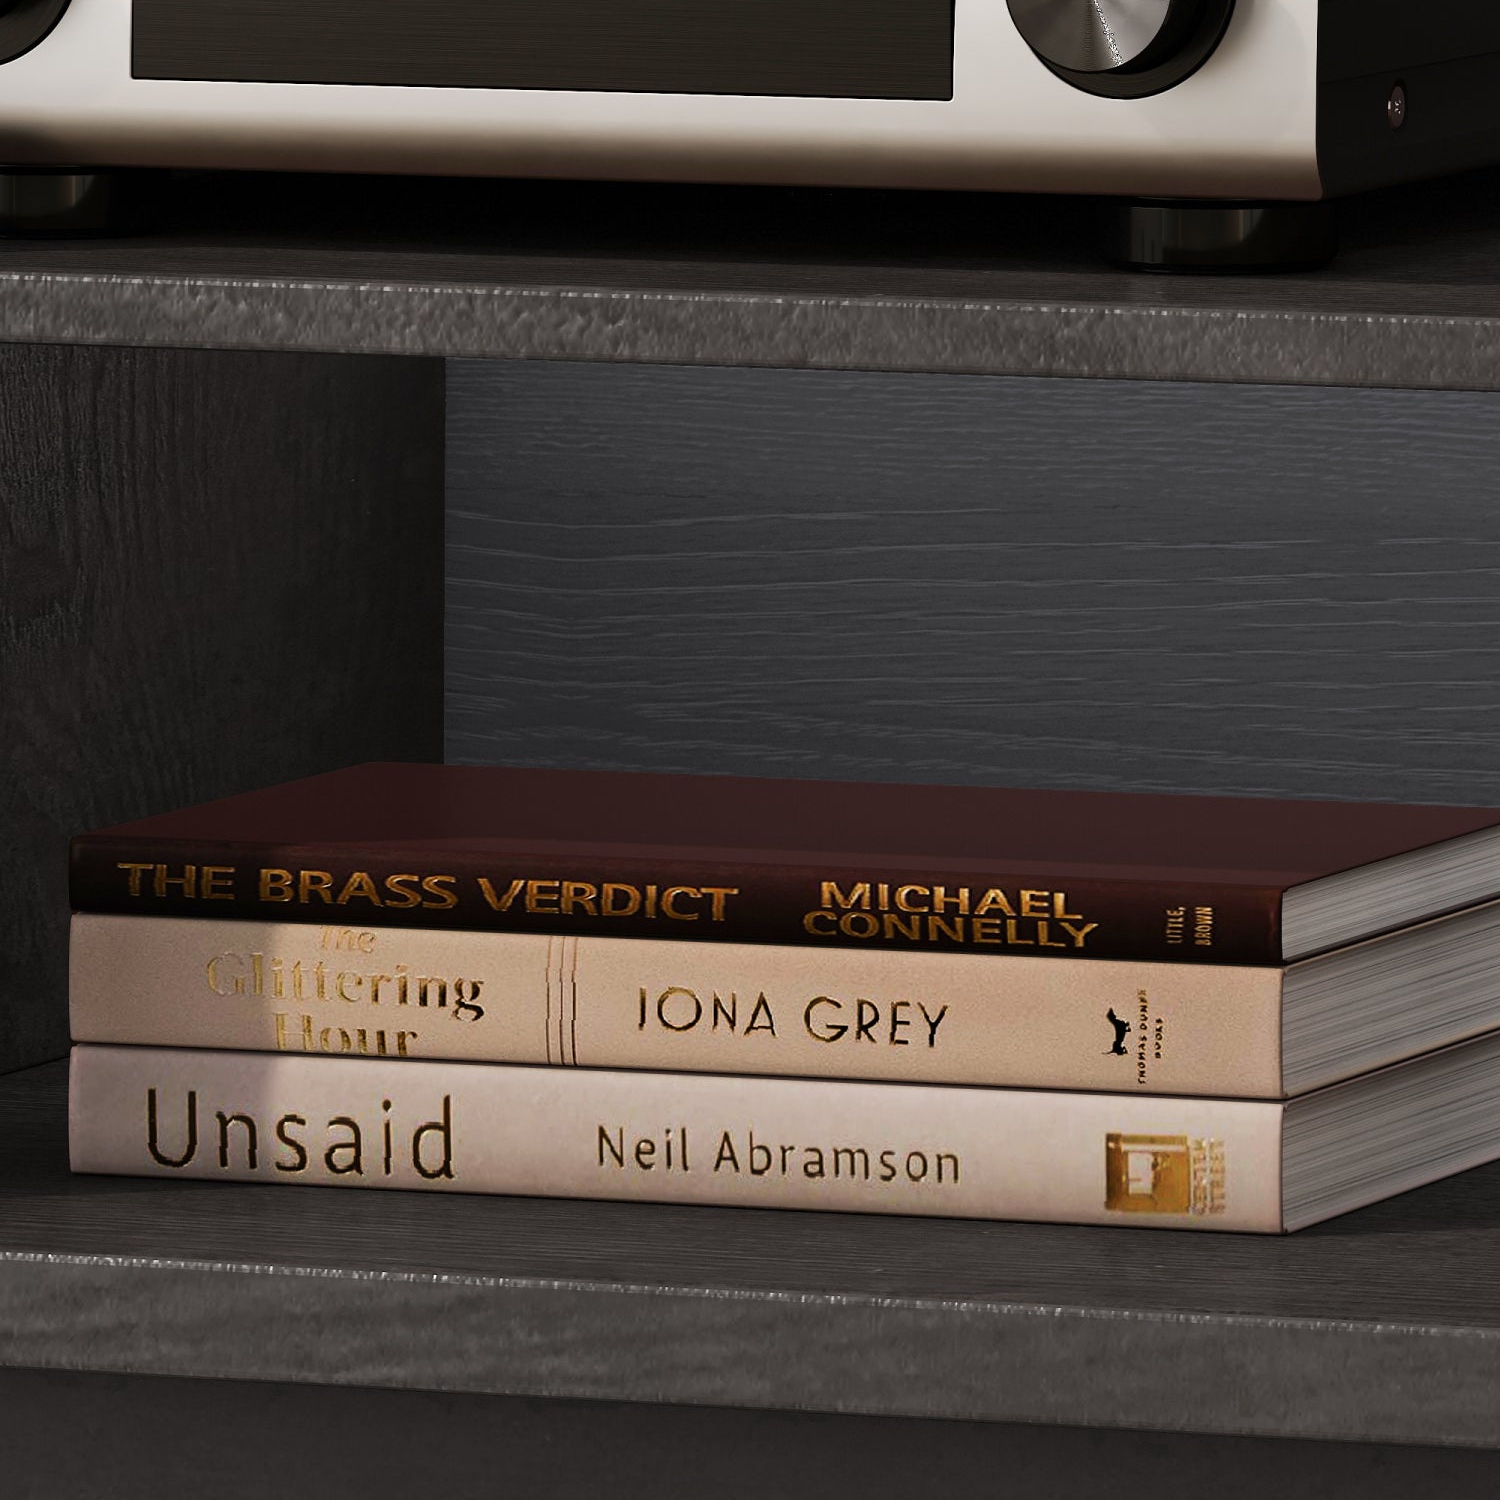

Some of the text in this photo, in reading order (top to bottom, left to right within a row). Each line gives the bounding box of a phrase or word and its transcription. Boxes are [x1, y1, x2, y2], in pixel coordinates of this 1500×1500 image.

[116, 862, 739, 922] THE BRASS VERDICT
[818, 881, 1083, 920] MICHAEL
[802, 908, 1099, 948] CONNELLY
[1166, 907, 1185, 943] LITTLE,
[1194, 906, 1213, 946] BROWN
[206, 951, 485, 1022] Glittering
[274, 1012, 418, 1056] Hour
[637, 987, 950, 1048] IONA GREY
[146, 1087, 456, 1180] Unsaid
[598, 1125, 960, 1185] Neil Abramson
